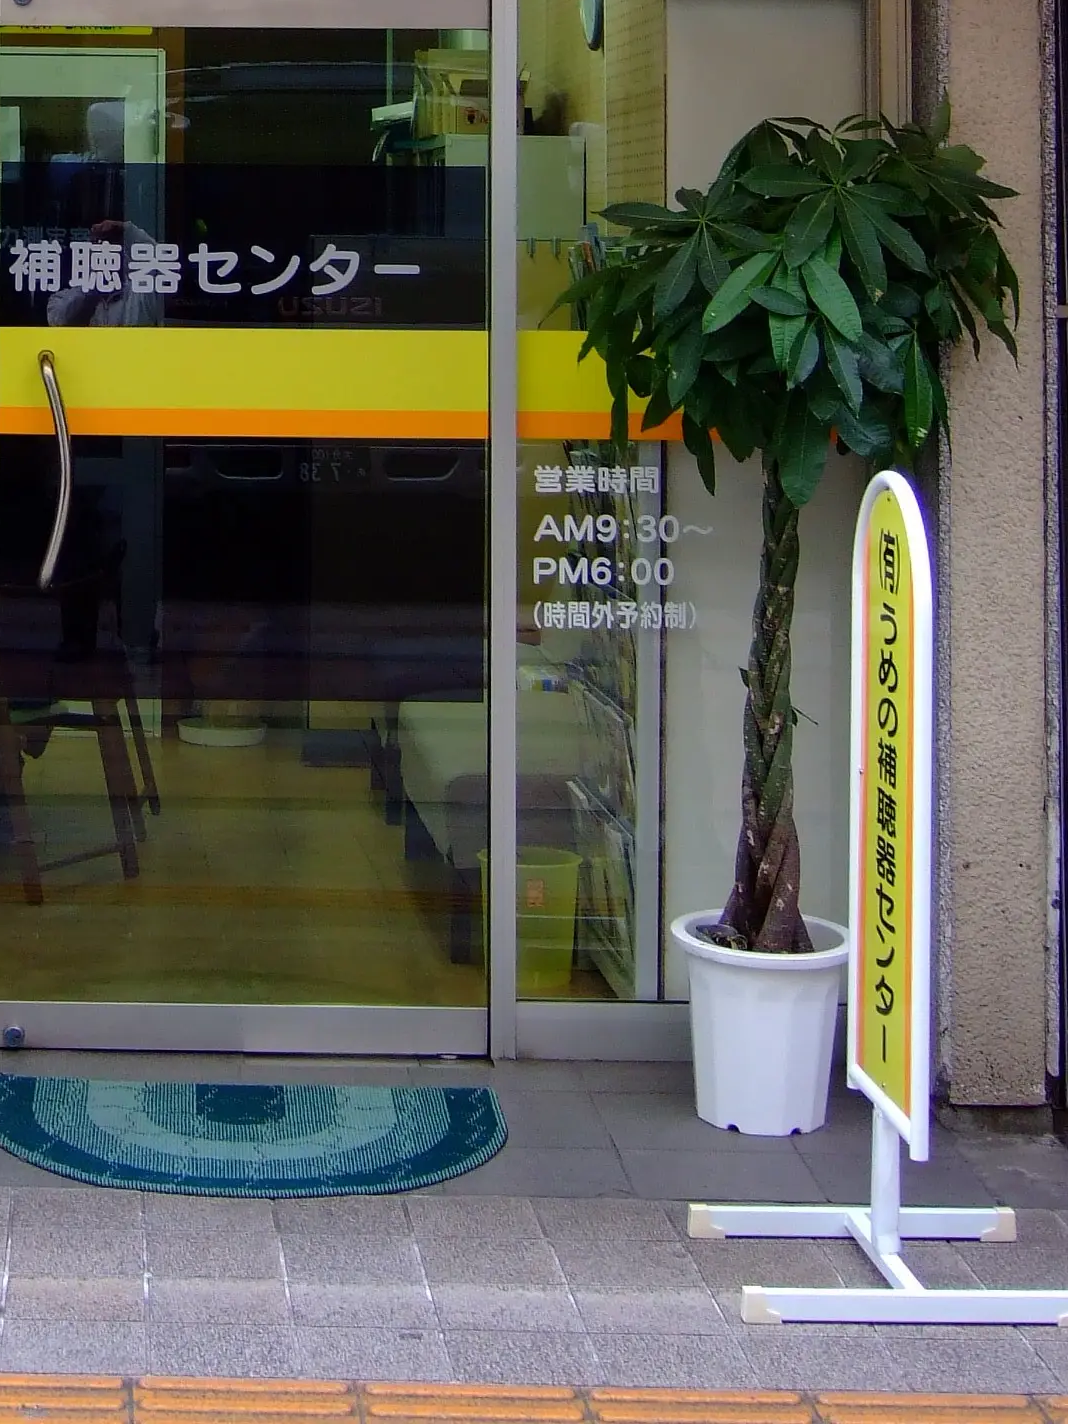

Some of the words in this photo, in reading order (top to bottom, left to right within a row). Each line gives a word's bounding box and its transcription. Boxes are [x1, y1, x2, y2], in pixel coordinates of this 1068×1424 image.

[533, 465, 660, 494] 営業時間
[533, 557, 675, 585] PM6:00
[533, 600, 698, 629] (時間外予約制)
